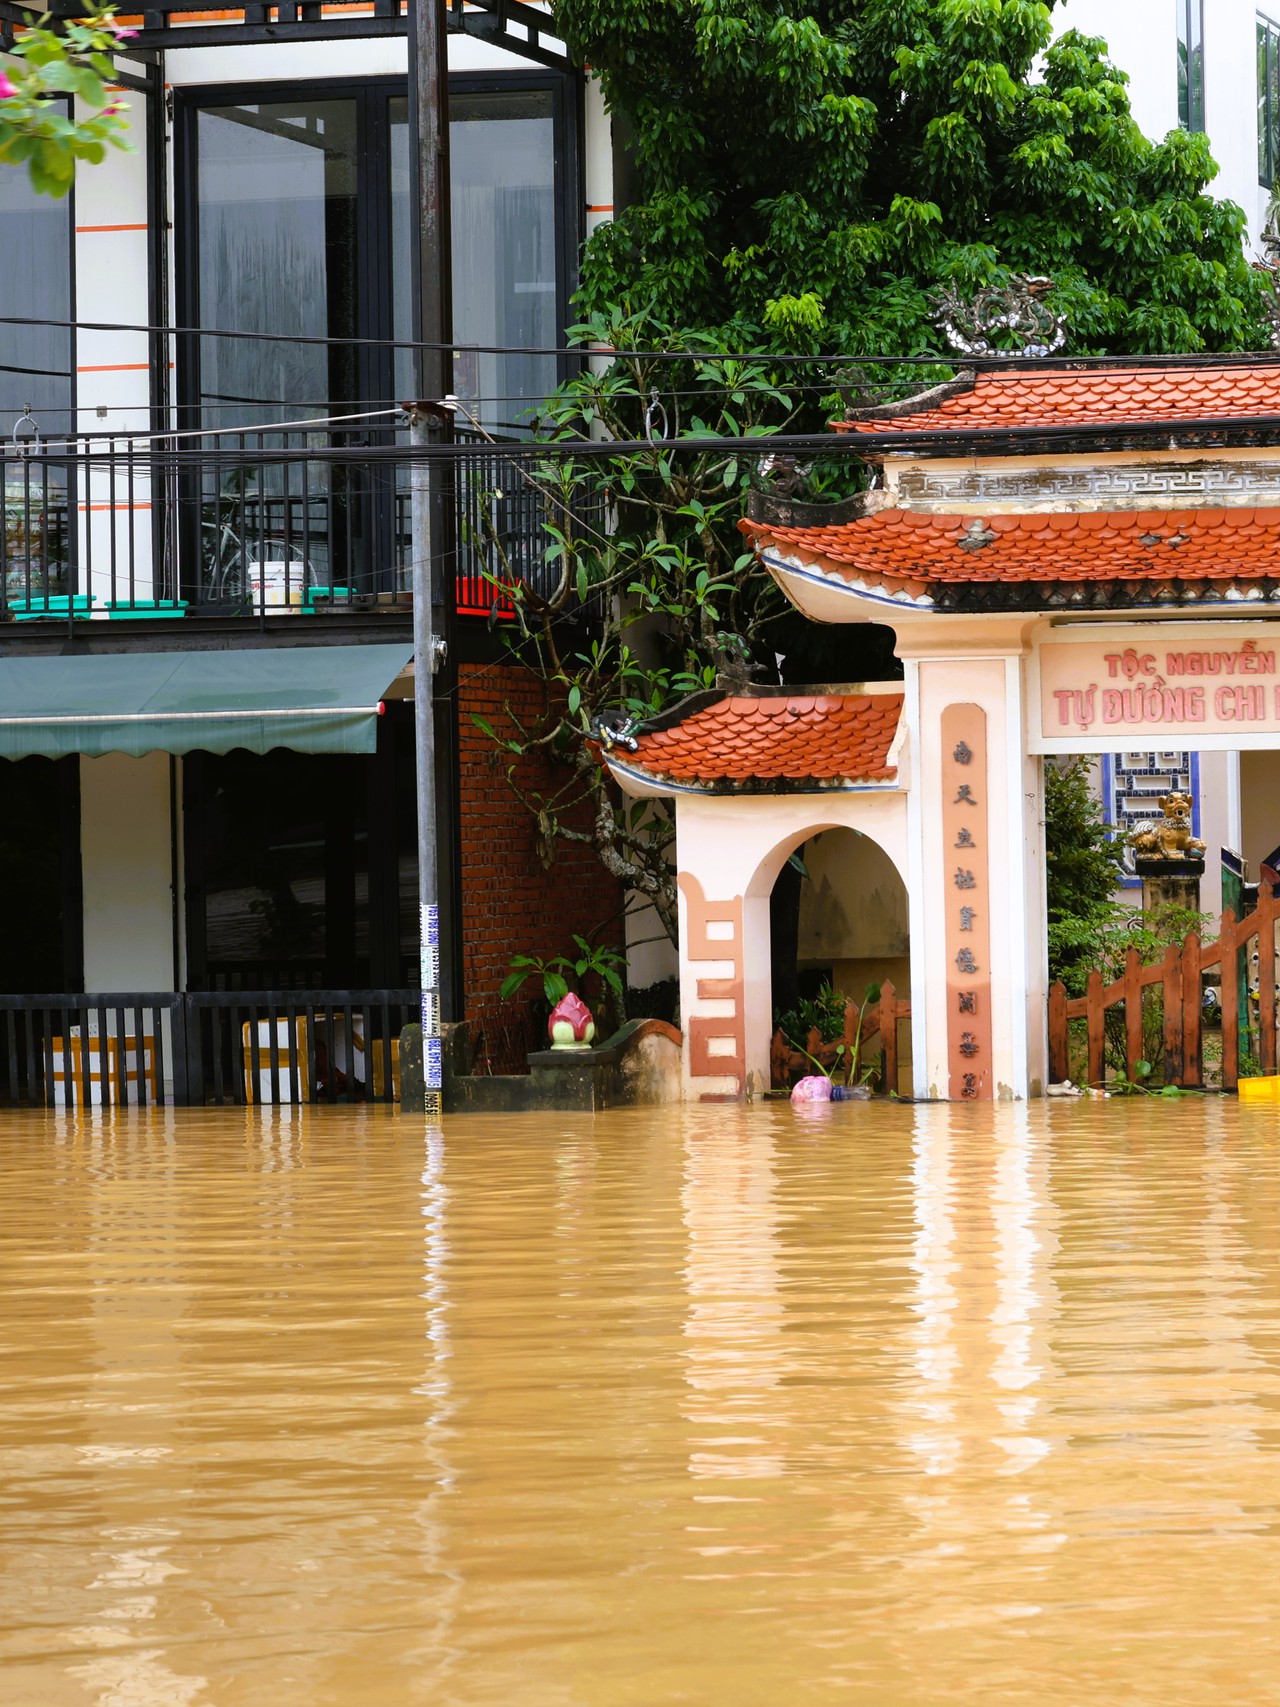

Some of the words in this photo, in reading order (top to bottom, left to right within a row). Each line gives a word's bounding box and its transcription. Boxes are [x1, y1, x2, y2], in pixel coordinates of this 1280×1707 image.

[1104, 649, 1157, 681] TỘC
[1166, 640, 1275, 676] NGUYỄN
[1053, 683, 1097, 731] TỰ
[1102, 675, 1206, 724] ĐƯỜNG
[1214, 685, 1266, 721] CHI
[428, 1039, 441, 1051] 789
[428, 1052, 441, 1064] 649
[428, 1065, 441, 1078] 0931
